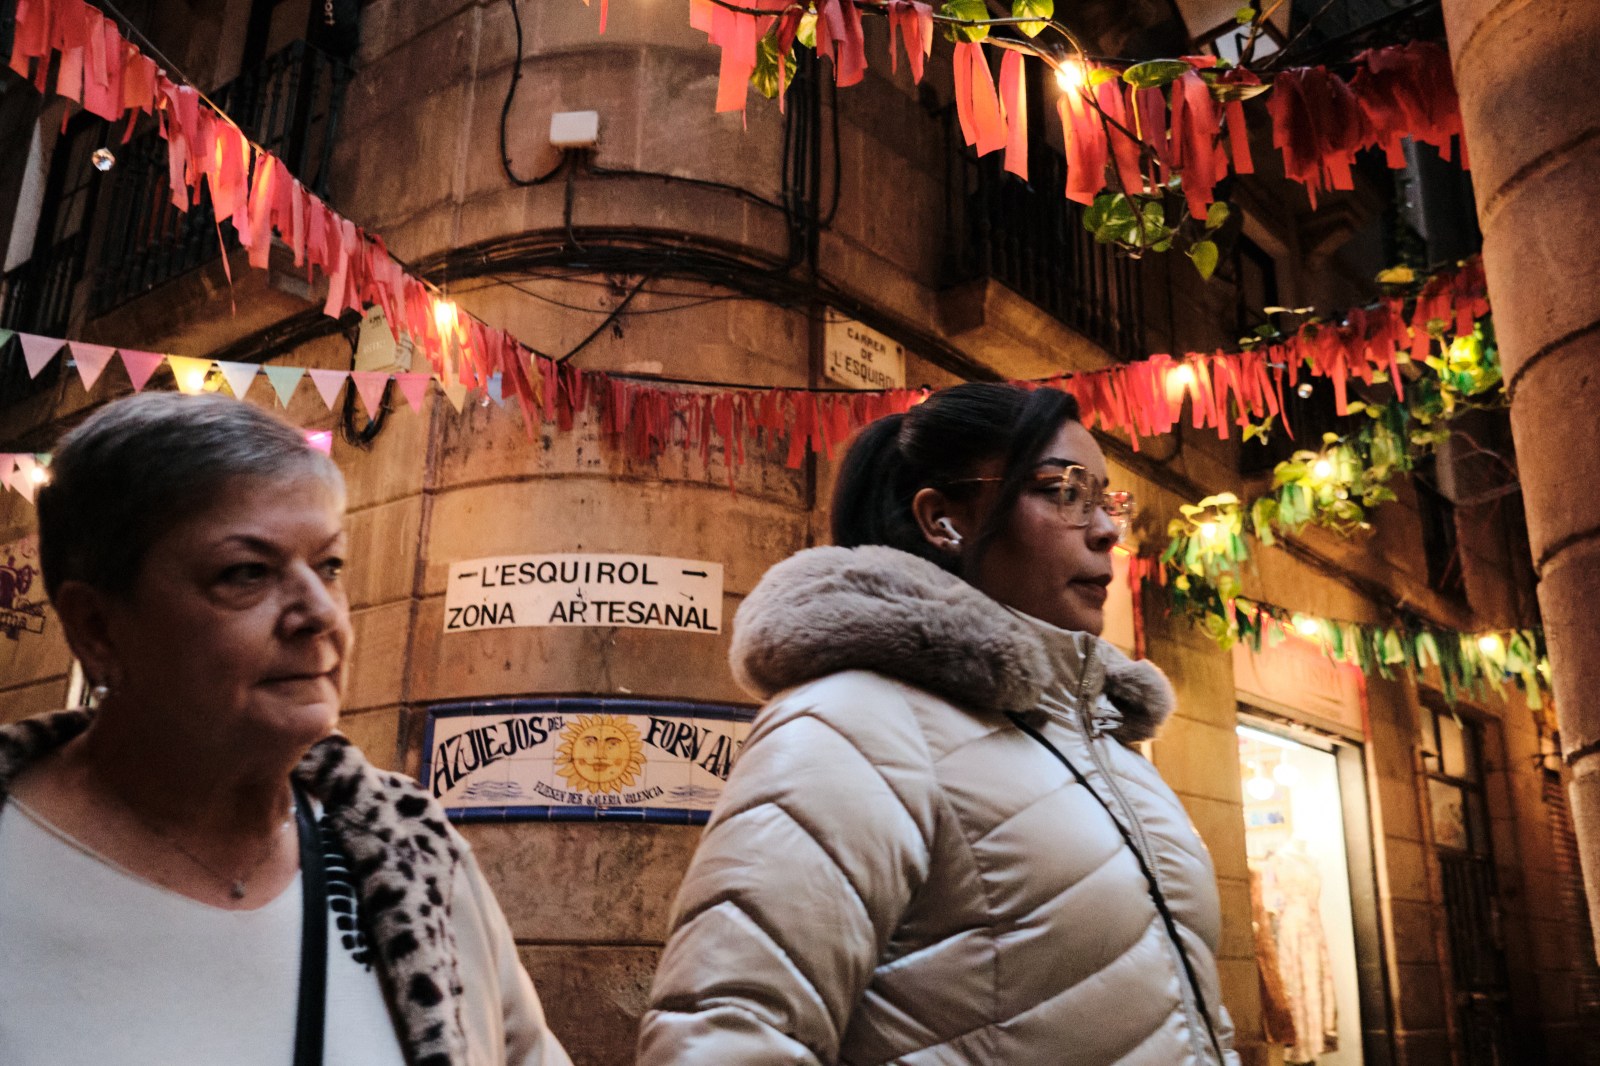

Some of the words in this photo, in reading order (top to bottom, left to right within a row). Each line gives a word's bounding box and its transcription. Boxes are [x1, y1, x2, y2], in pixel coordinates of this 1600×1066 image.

[846, 327, 886, 355] CARRER
[861, 348, 872, 363] DE
[481, 561, 658, 587] L'ESQUIROL
[447, 602, 516, 629] ZONA
[549, 600, 718, 631] ARTESANAL
[433, 716, 548, 799] AZULEJOS
[547, 715, 566, 732] DEL
[623, 785, 665, 805] VALENCIA
